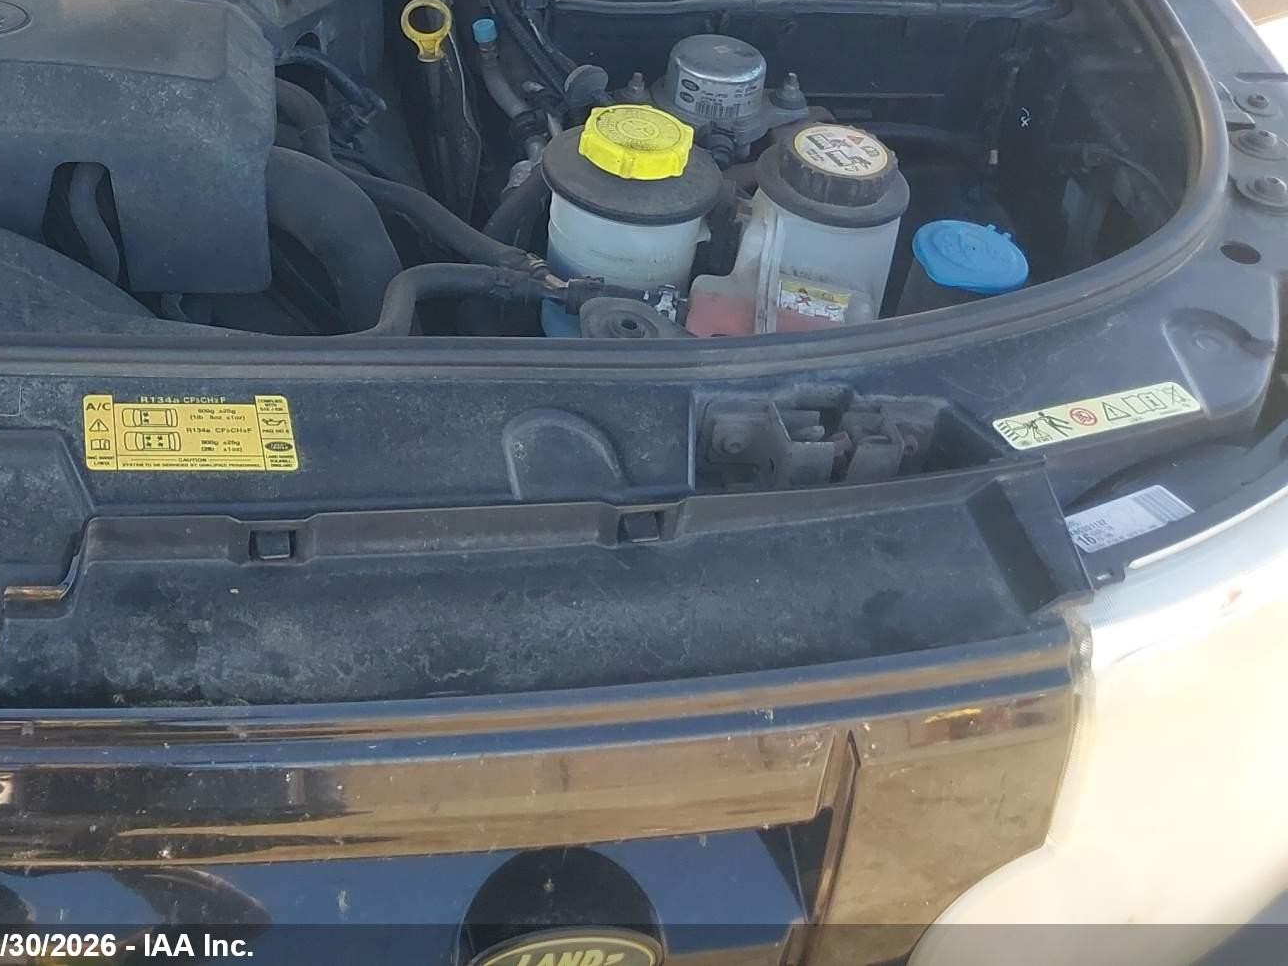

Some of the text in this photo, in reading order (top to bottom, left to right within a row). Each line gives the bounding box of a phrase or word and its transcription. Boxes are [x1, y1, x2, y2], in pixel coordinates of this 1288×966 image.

[140, 396, 180, 404] R134a
[85, 402, 112, 411] A/C
[1077, 534, 1097, 546] 16
